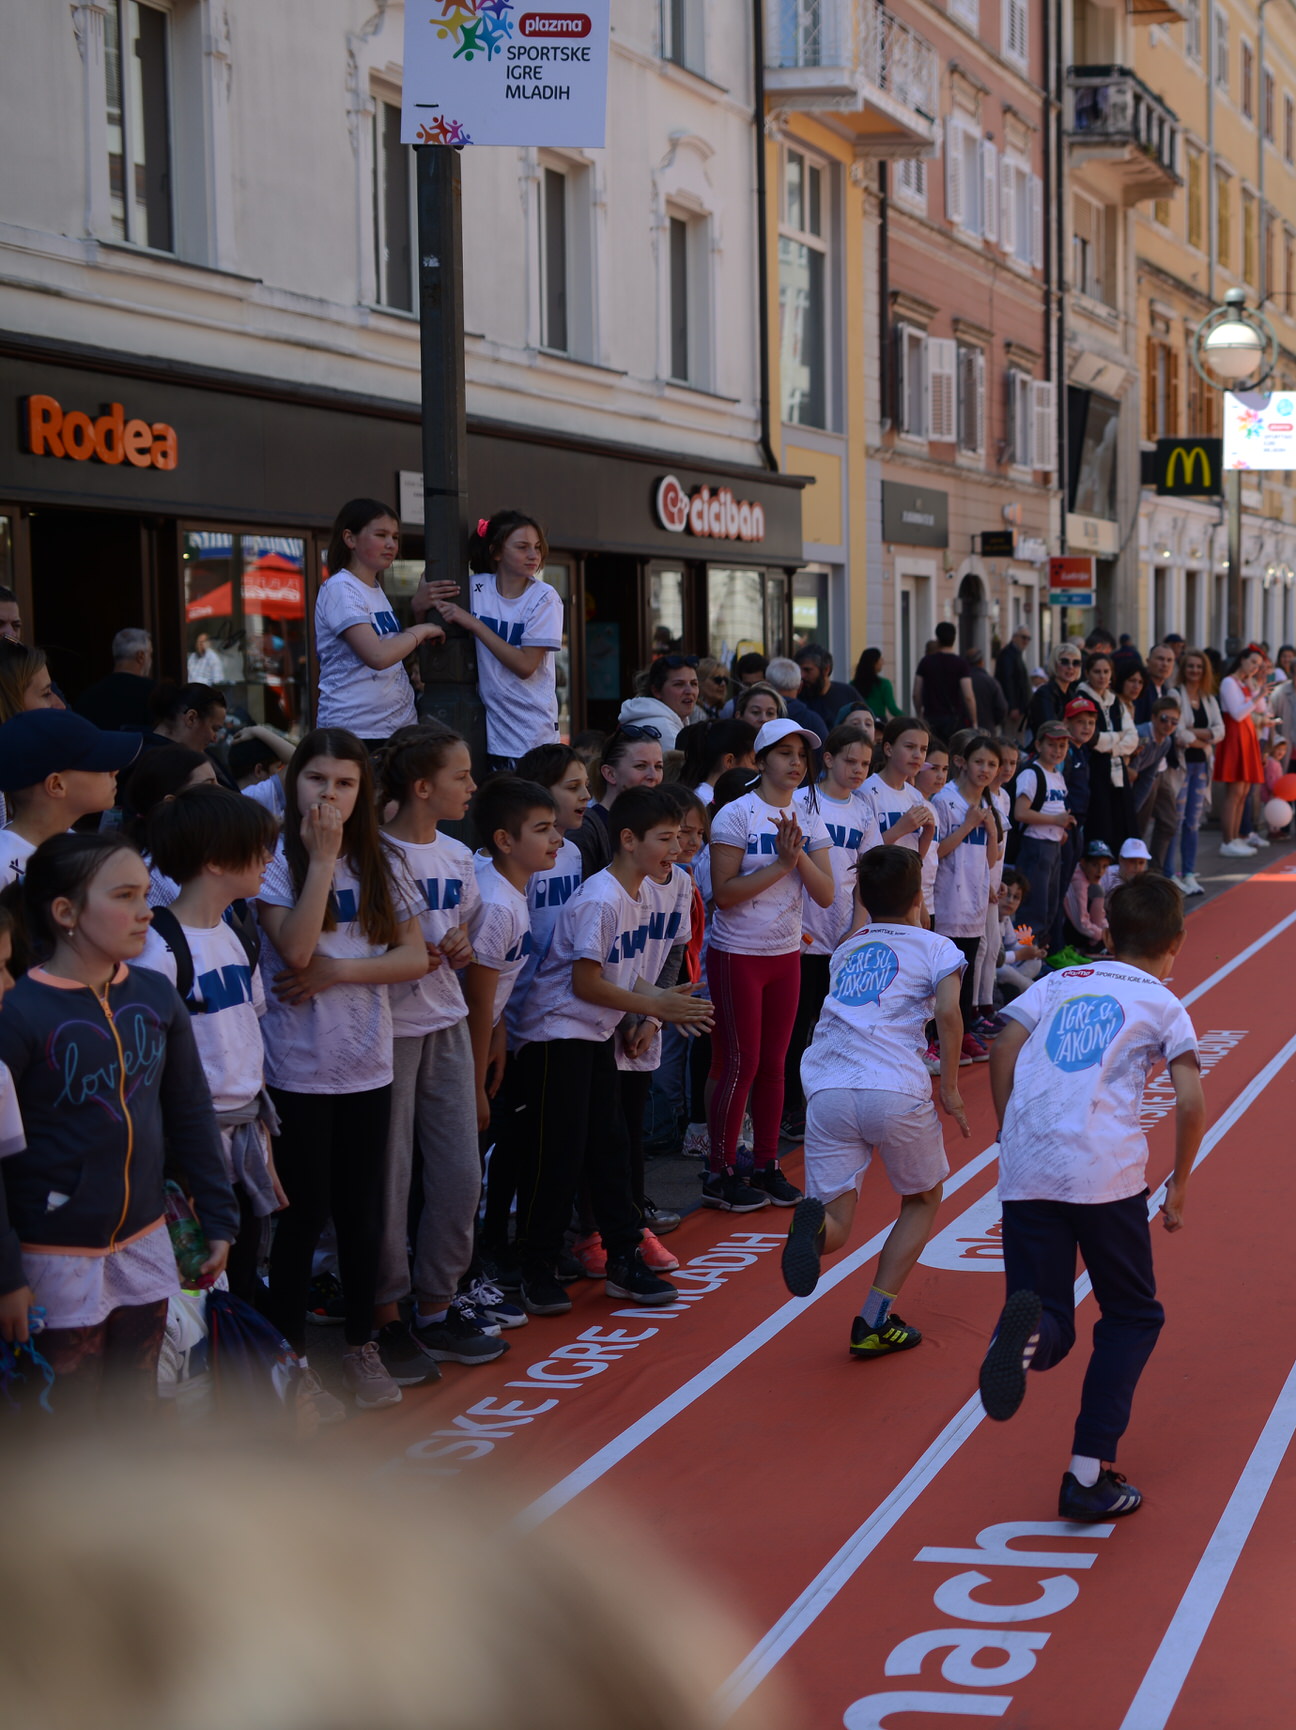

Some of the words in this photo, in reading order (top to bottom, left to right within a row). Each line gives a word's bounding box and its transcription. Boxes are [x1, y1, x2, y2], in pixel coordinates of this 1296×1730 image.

[525, 16, 582, 34] plazma
[507, 46, 591, 61] SPORTSKE
[506, 65, 543, 80] IGRE
[505, 84, 570, 100] MLADIH
[28, 394, 178, 471] Rodea
[690, 484, 765, 541] ciciban
[54, 1014, 165, 1106] lovely
[504, 1325, 659, 1389] IGRE
